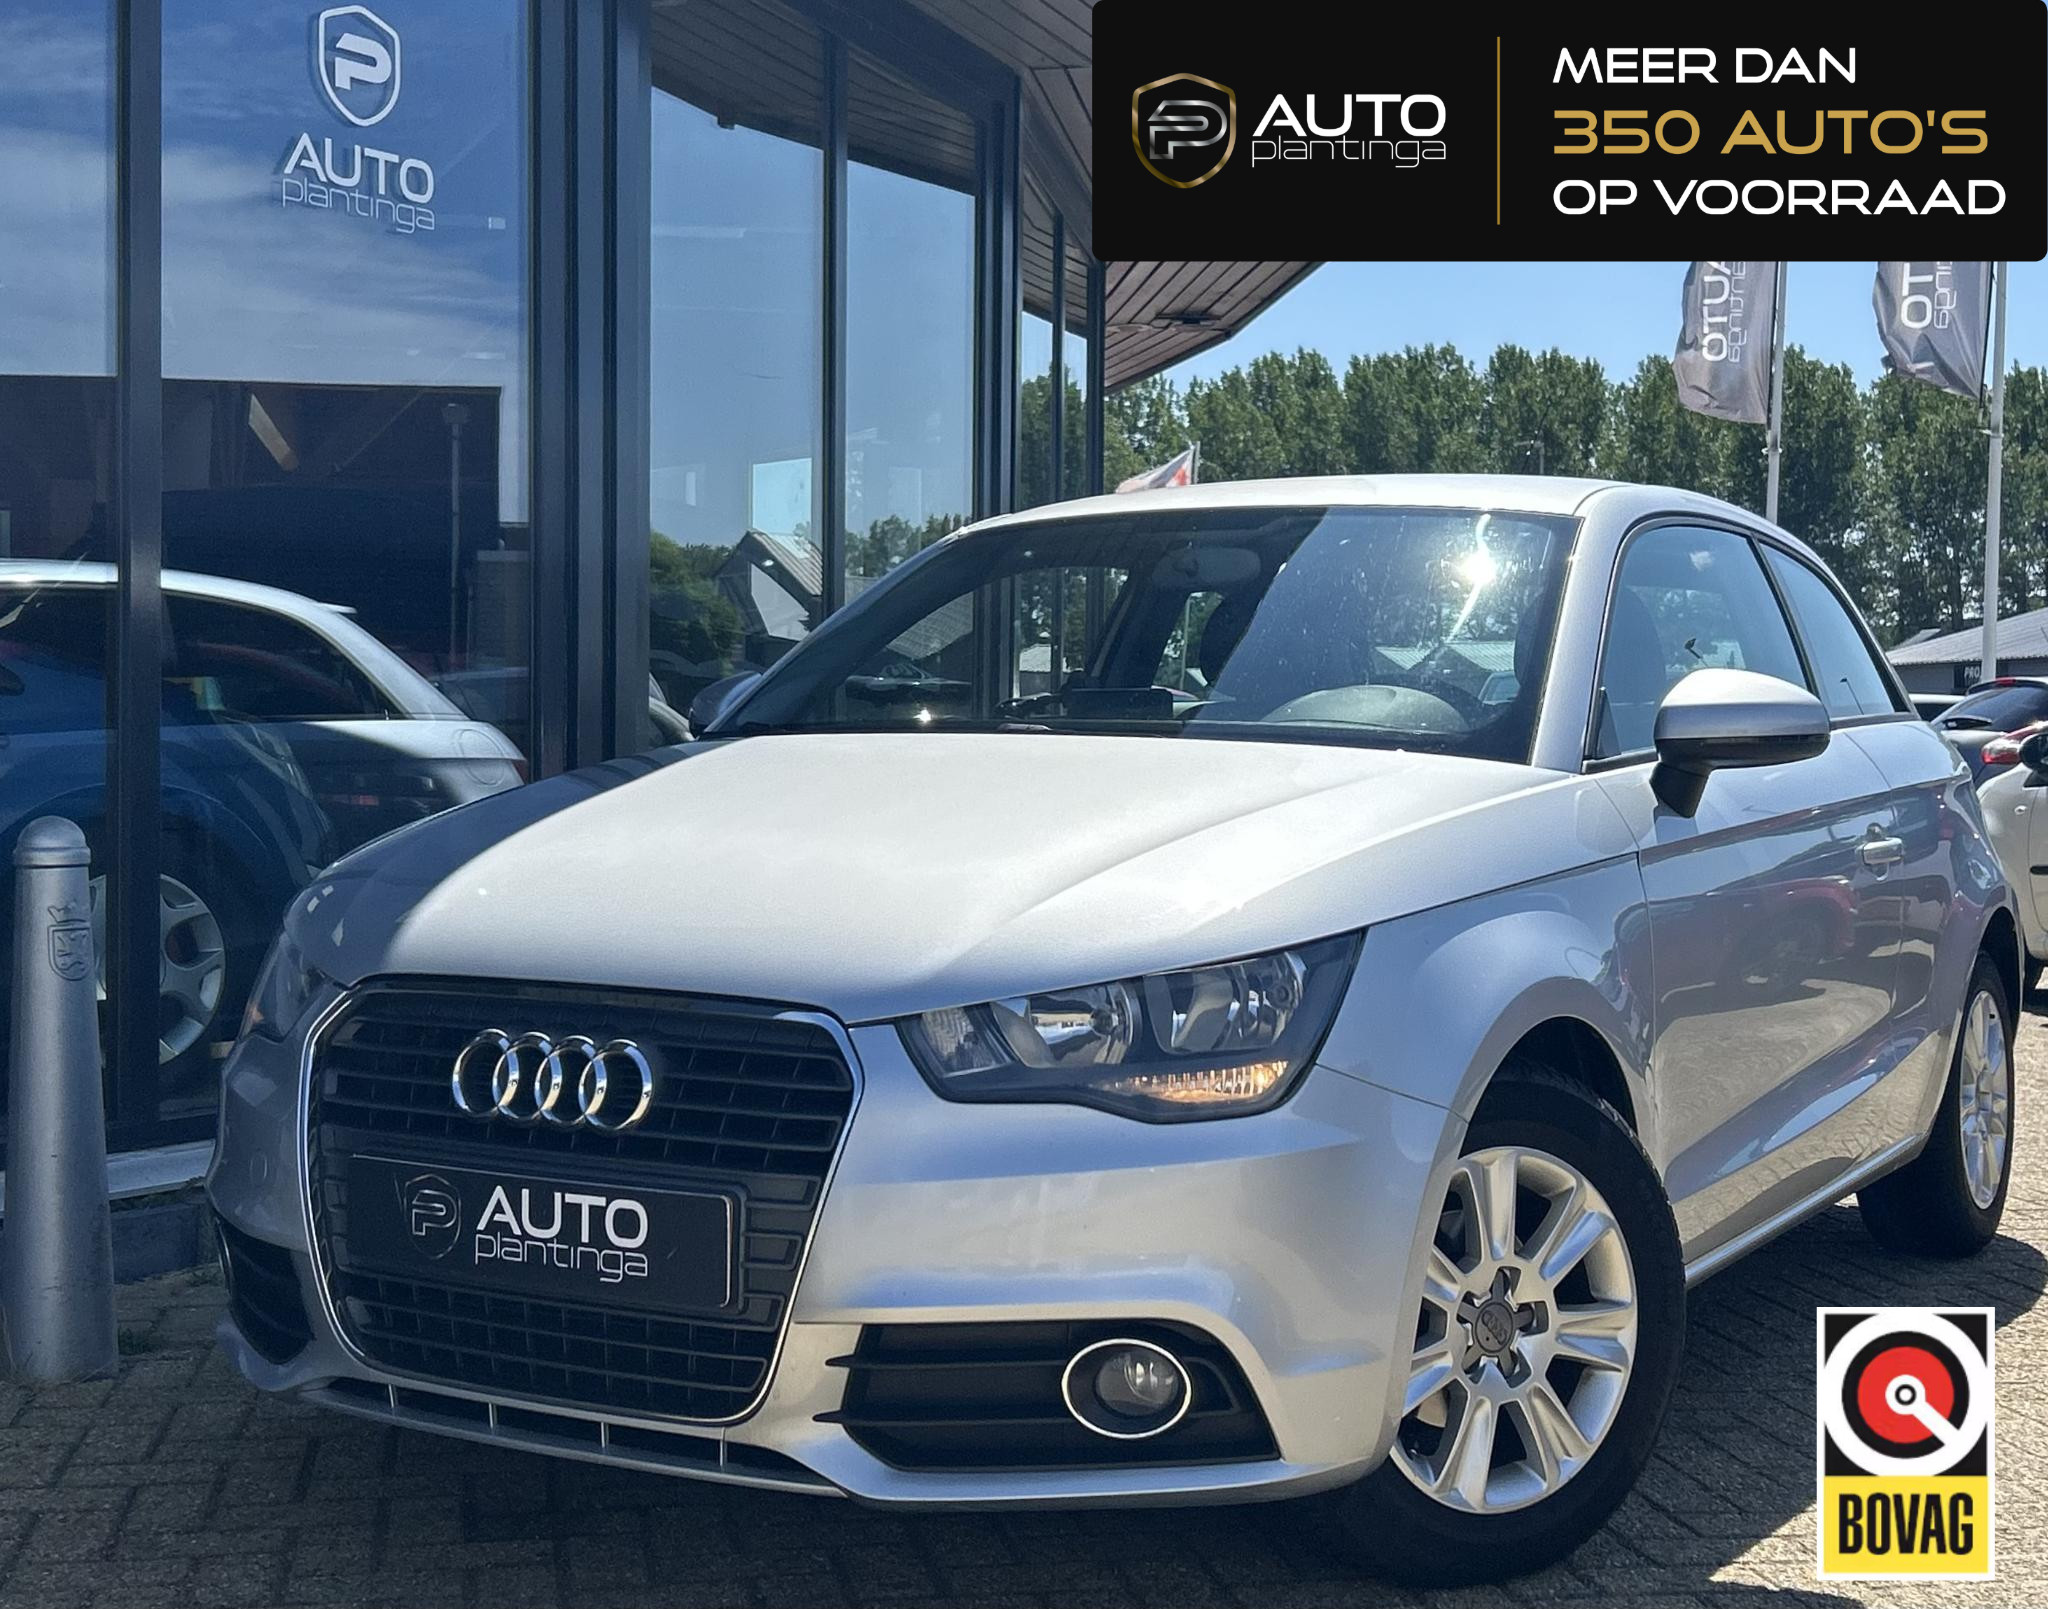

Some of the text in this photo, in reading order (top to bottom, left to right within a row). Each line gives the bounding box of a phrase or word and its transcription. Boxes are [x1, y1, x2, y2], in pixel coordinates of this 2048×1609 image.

[283, 132, 435, 204] AUTO
[281, 177, 435, 234] plantinga
[476, 1186, 648, 1248] AUTO
[475, 1232, 648, 1284] plantinga
